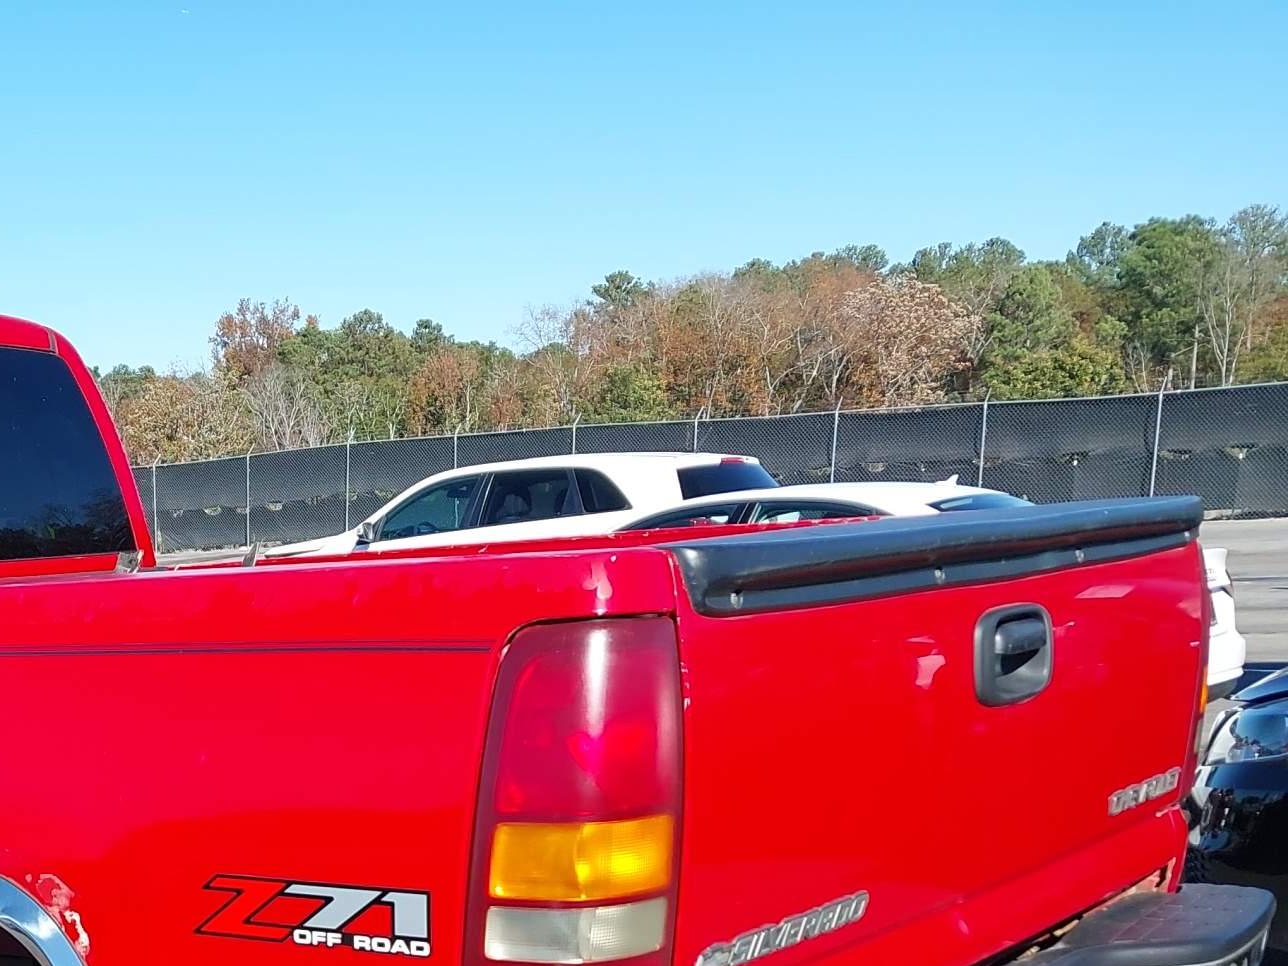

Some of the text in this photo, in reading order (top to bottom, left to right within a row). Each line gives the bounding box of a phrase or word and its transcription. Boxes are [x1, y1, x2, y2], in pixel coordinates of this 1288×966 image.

[193, 873, 431, 944] Z71
[292, 929, 431, 957] OFF ROAD
[727, 890, 869, 966] SILVERADO
